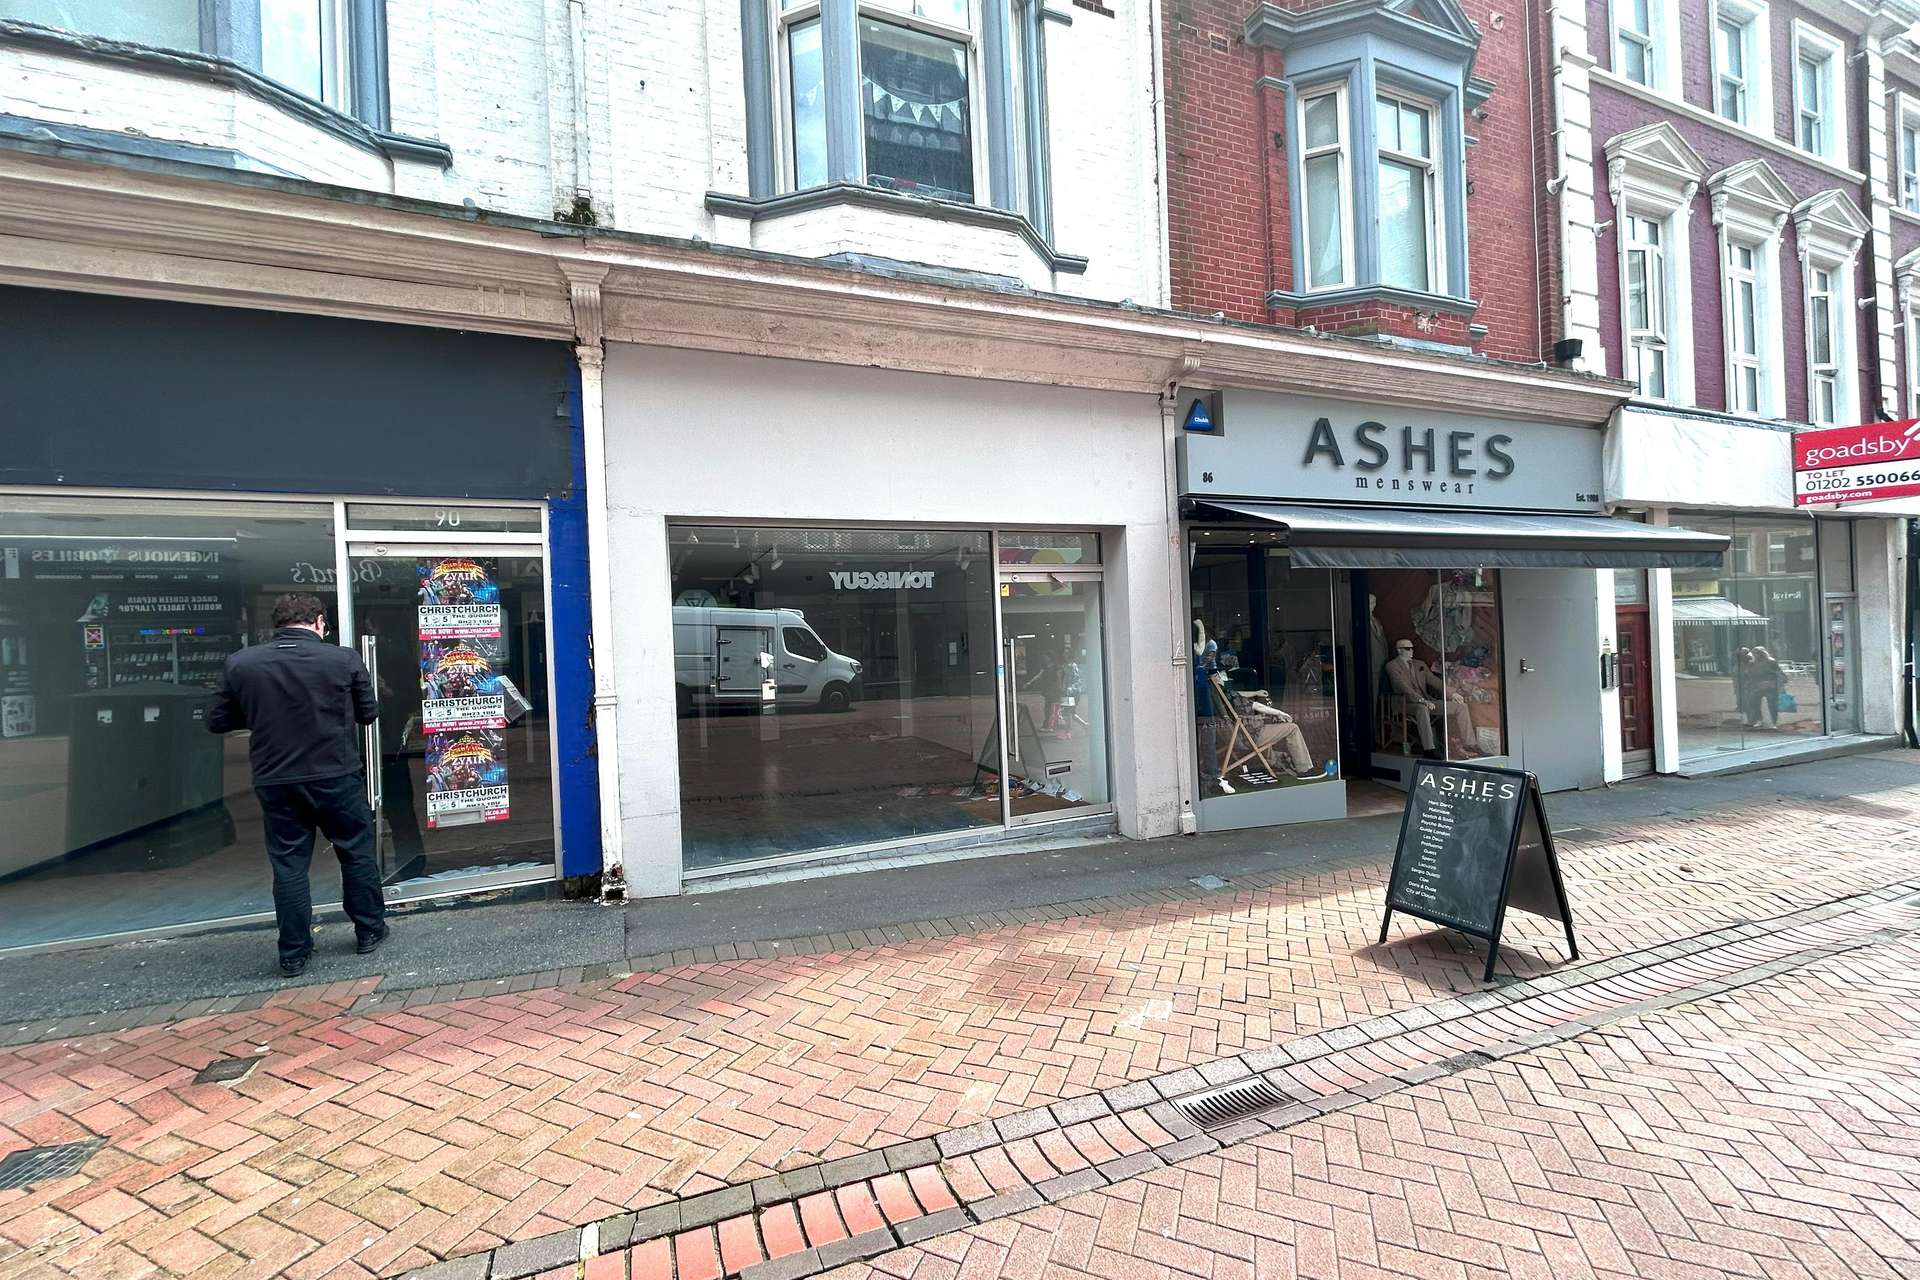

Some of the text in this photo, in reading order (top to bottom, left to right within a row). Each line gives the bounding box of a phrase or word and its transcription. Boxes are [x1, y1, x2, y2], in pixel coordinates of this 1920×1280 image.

[1304, 417, 1515, 478] ASHES
[1805, 435, 1911, 466] goadsby
[1202, 471, 1213, 483] 86
[1805, 470, 1920, 491] 01202 550066
[1807, 470, 1845, 480] TO LET
[1356, 476, 1474, 494] menswear
[1806, 491, 1872, 503] goadsby.com
[434, 510, 460, 526] 90
[443, 572, 478, 581] ZYAIR
[420, 606, 499, 614] CHRISTCHURCH
[447, 664, 481, 674] ZYAIR
[424, 696, 503, 708] CHRISTCHURCH
[451, 755, 486, 766] ZYAIR
[1420, 773, 1515, 800] ASHES
[428, 787, 507, 801] CHRISTCHURCH
